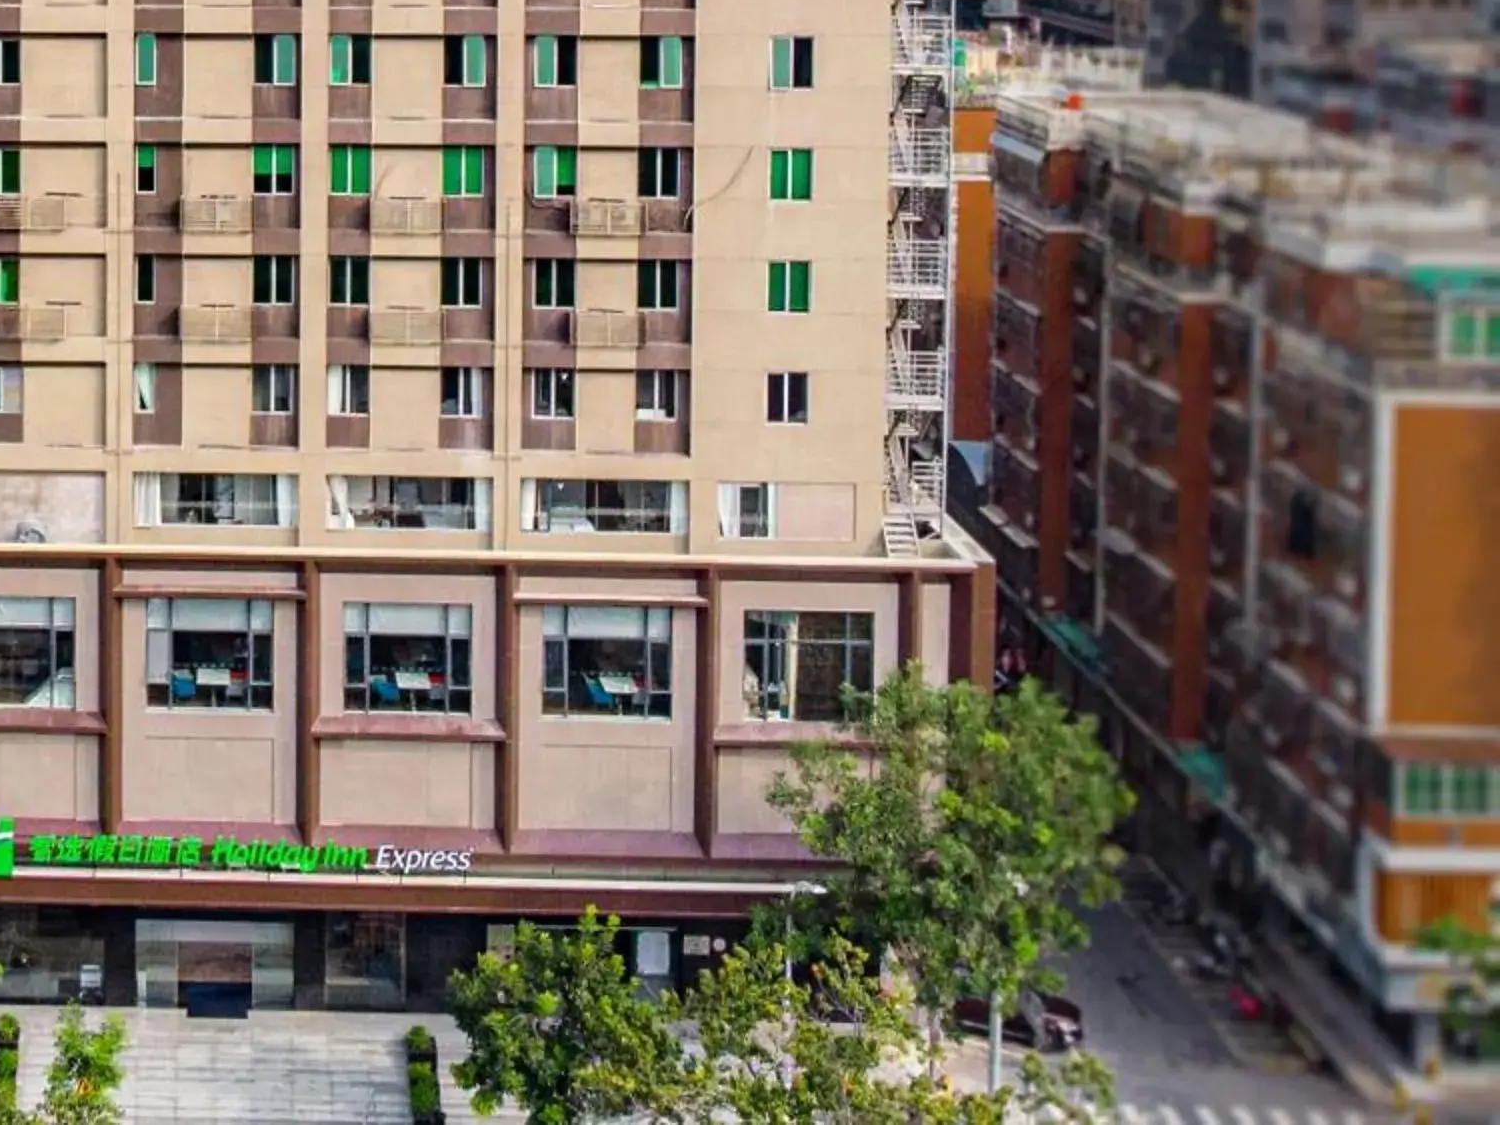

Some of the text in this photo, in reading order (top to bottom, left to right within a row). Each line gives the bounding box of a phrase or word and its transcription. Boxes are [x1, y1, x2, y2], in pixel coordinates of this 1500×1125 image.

[212, 836, 473, 874] Holiday Inn Express
